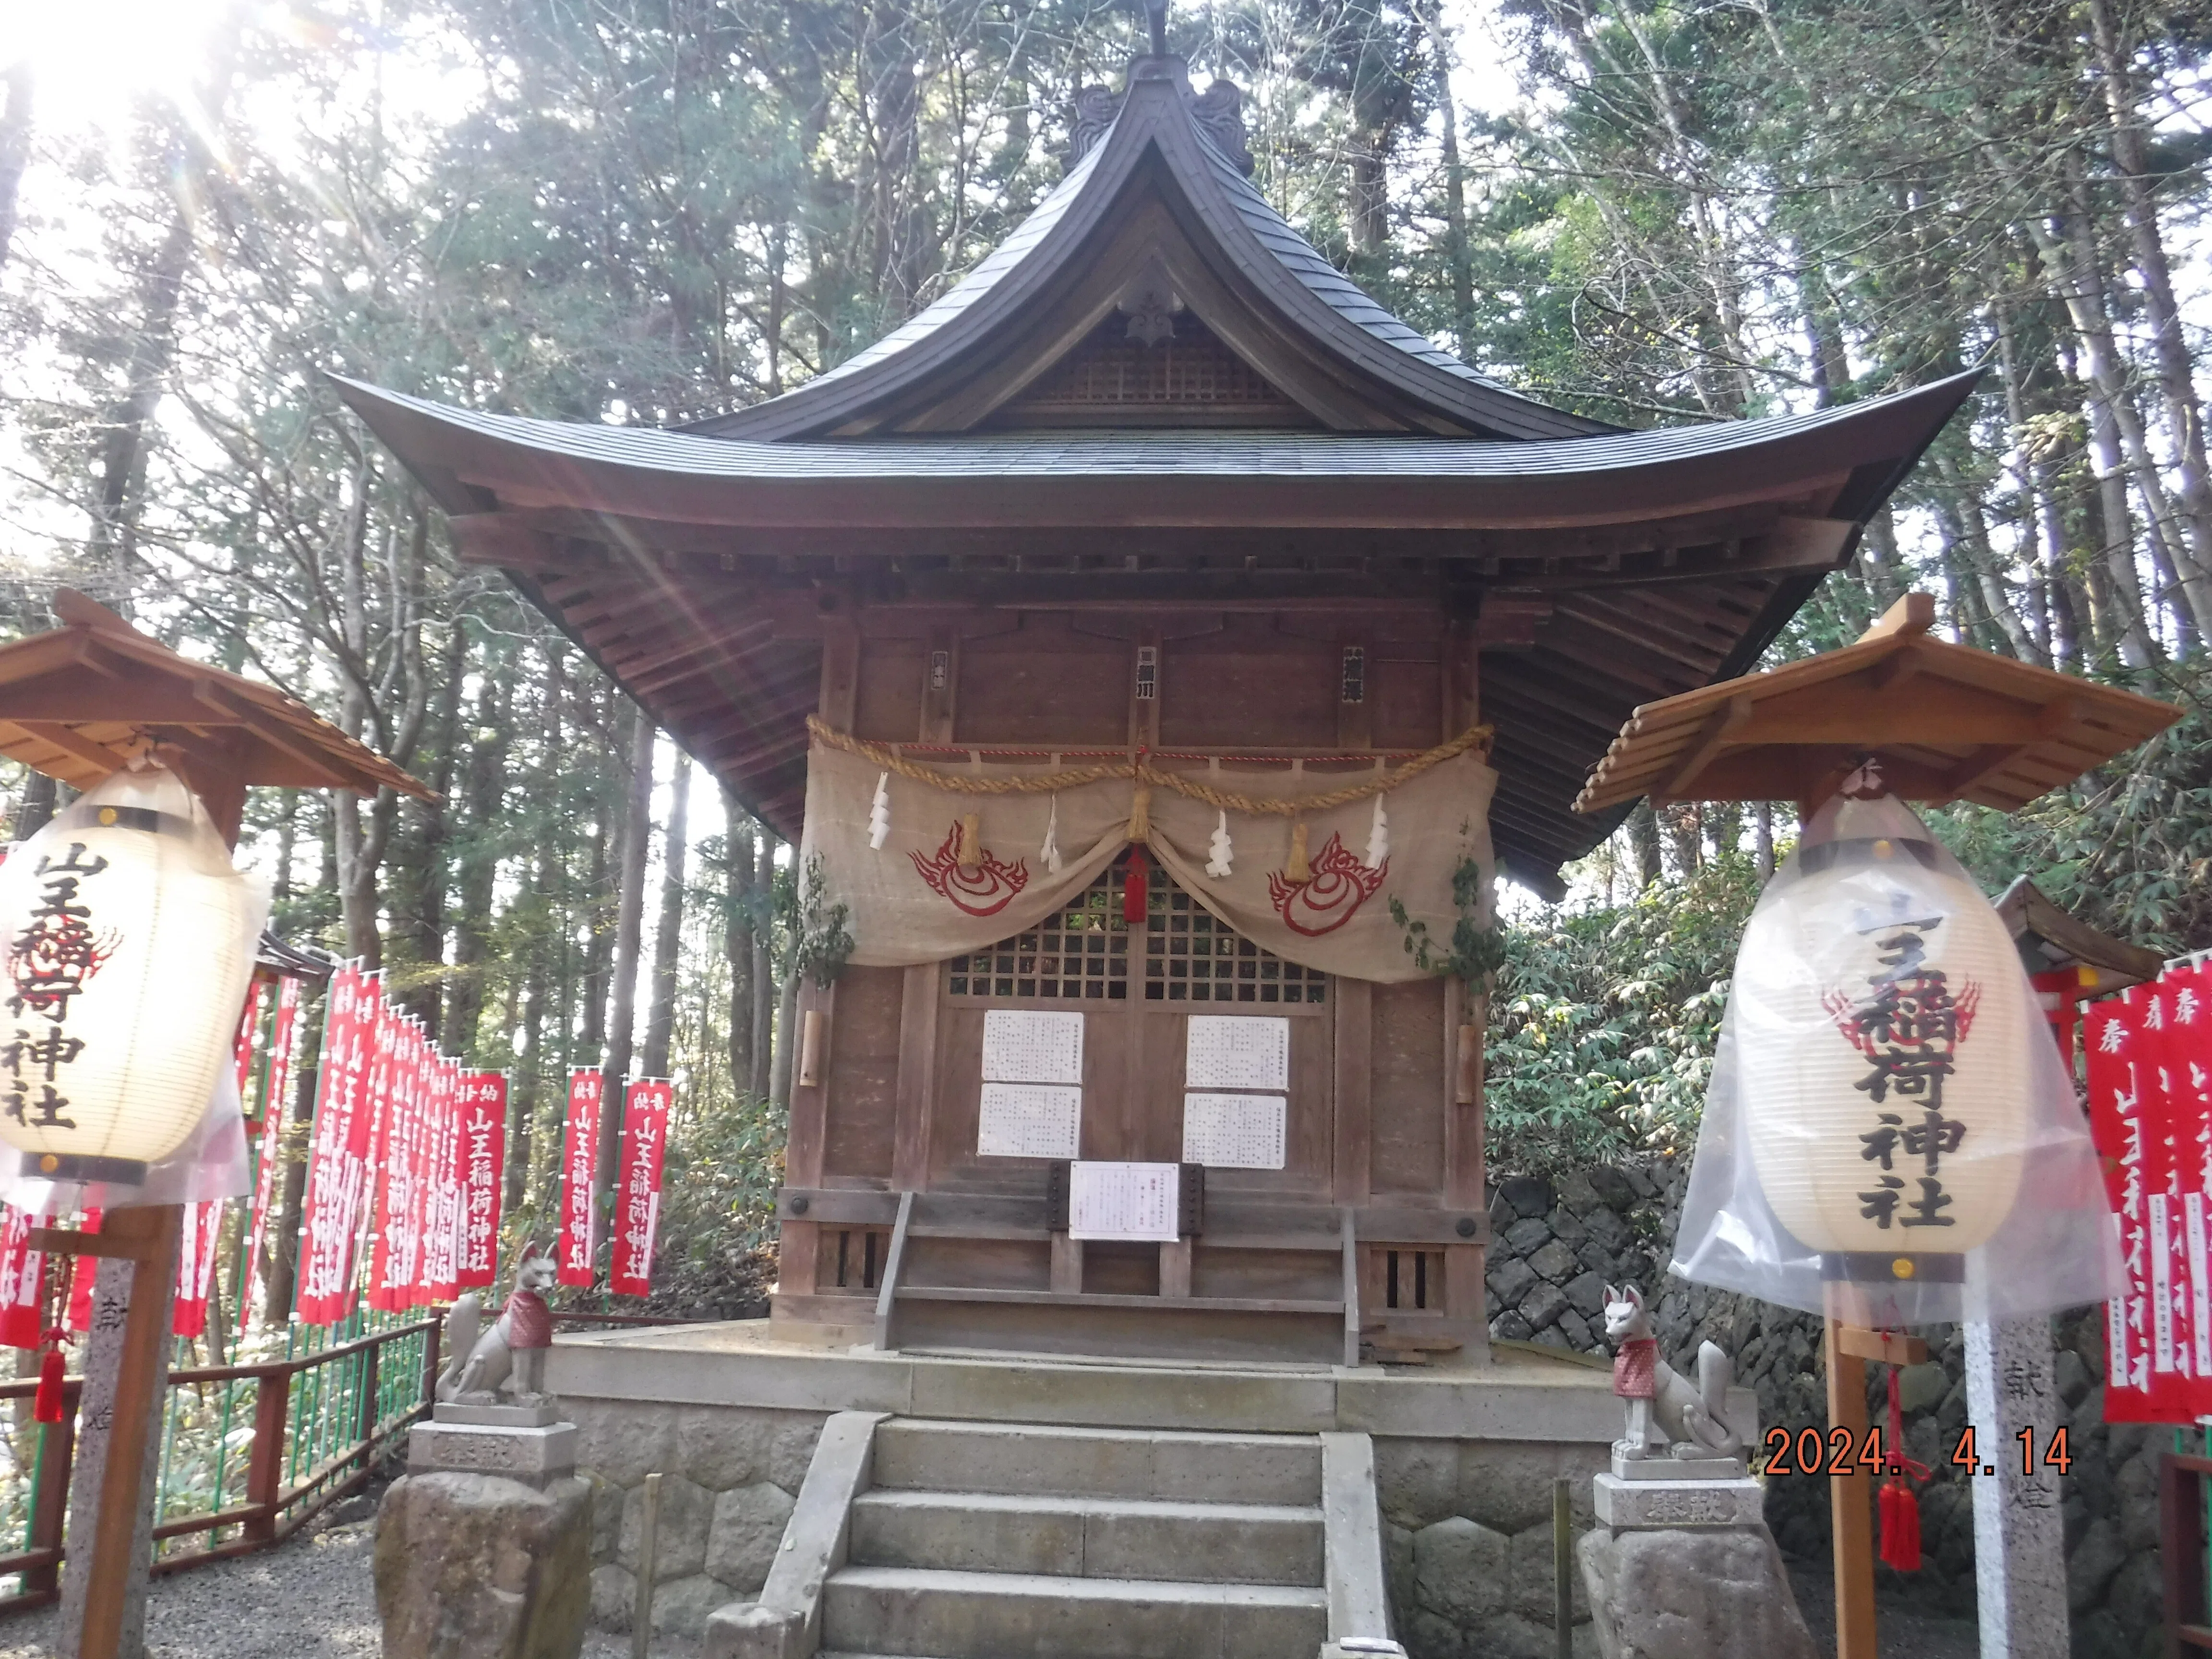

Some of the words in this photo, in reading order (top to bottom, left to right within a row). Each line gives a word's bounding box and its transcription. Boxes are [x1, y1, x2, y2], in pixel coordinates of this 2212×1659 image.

[1, 842, 108, 1129] 山王稲荷神社
[1852, 891, 1967, 1229] 山王稲荷神社
[466, 1107, 493, 1272] 山王稲荷神社
